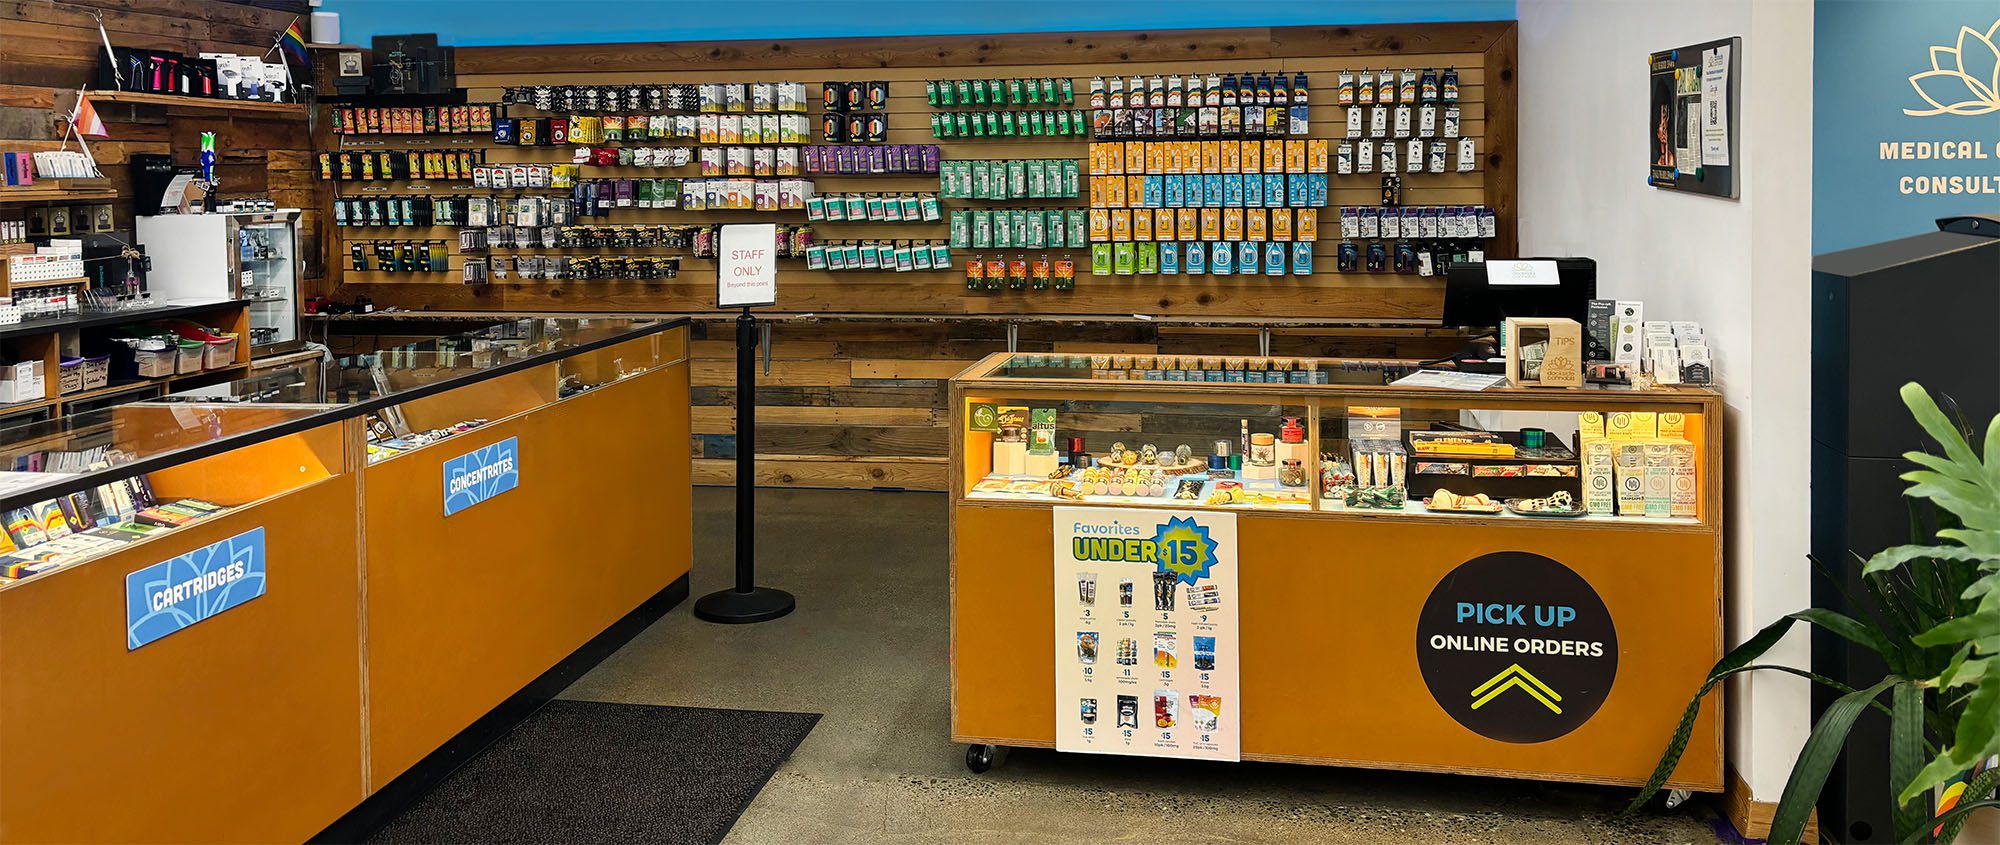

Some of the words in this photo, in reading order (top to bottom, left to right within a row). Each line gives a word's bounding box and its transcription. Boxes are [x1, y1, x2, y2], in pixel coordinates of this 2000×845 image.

[1879, 141, 1988, 160] MEDICAL
[731, 250, 764, 260] STAFF
[733, 266, 762, 277] ONLY
[1555, 337, 1575, 345] TIPS
[450, 456, 513, 494] CONCENTRATES
[1073, 520, 1140, 535] Favorites
[1073, 537, 1158, 563] UNDER
[1163, 540, 1198, 565] $15
[153, 560, 244, 612] CARTRIDGES
[1456, 602, 1527, 626] PICK
[1534, 605, 1576, 628] UP
[1430, 634, 1509, 653] ONLINE
[1513, 638, 1604, 657] ORDERS
